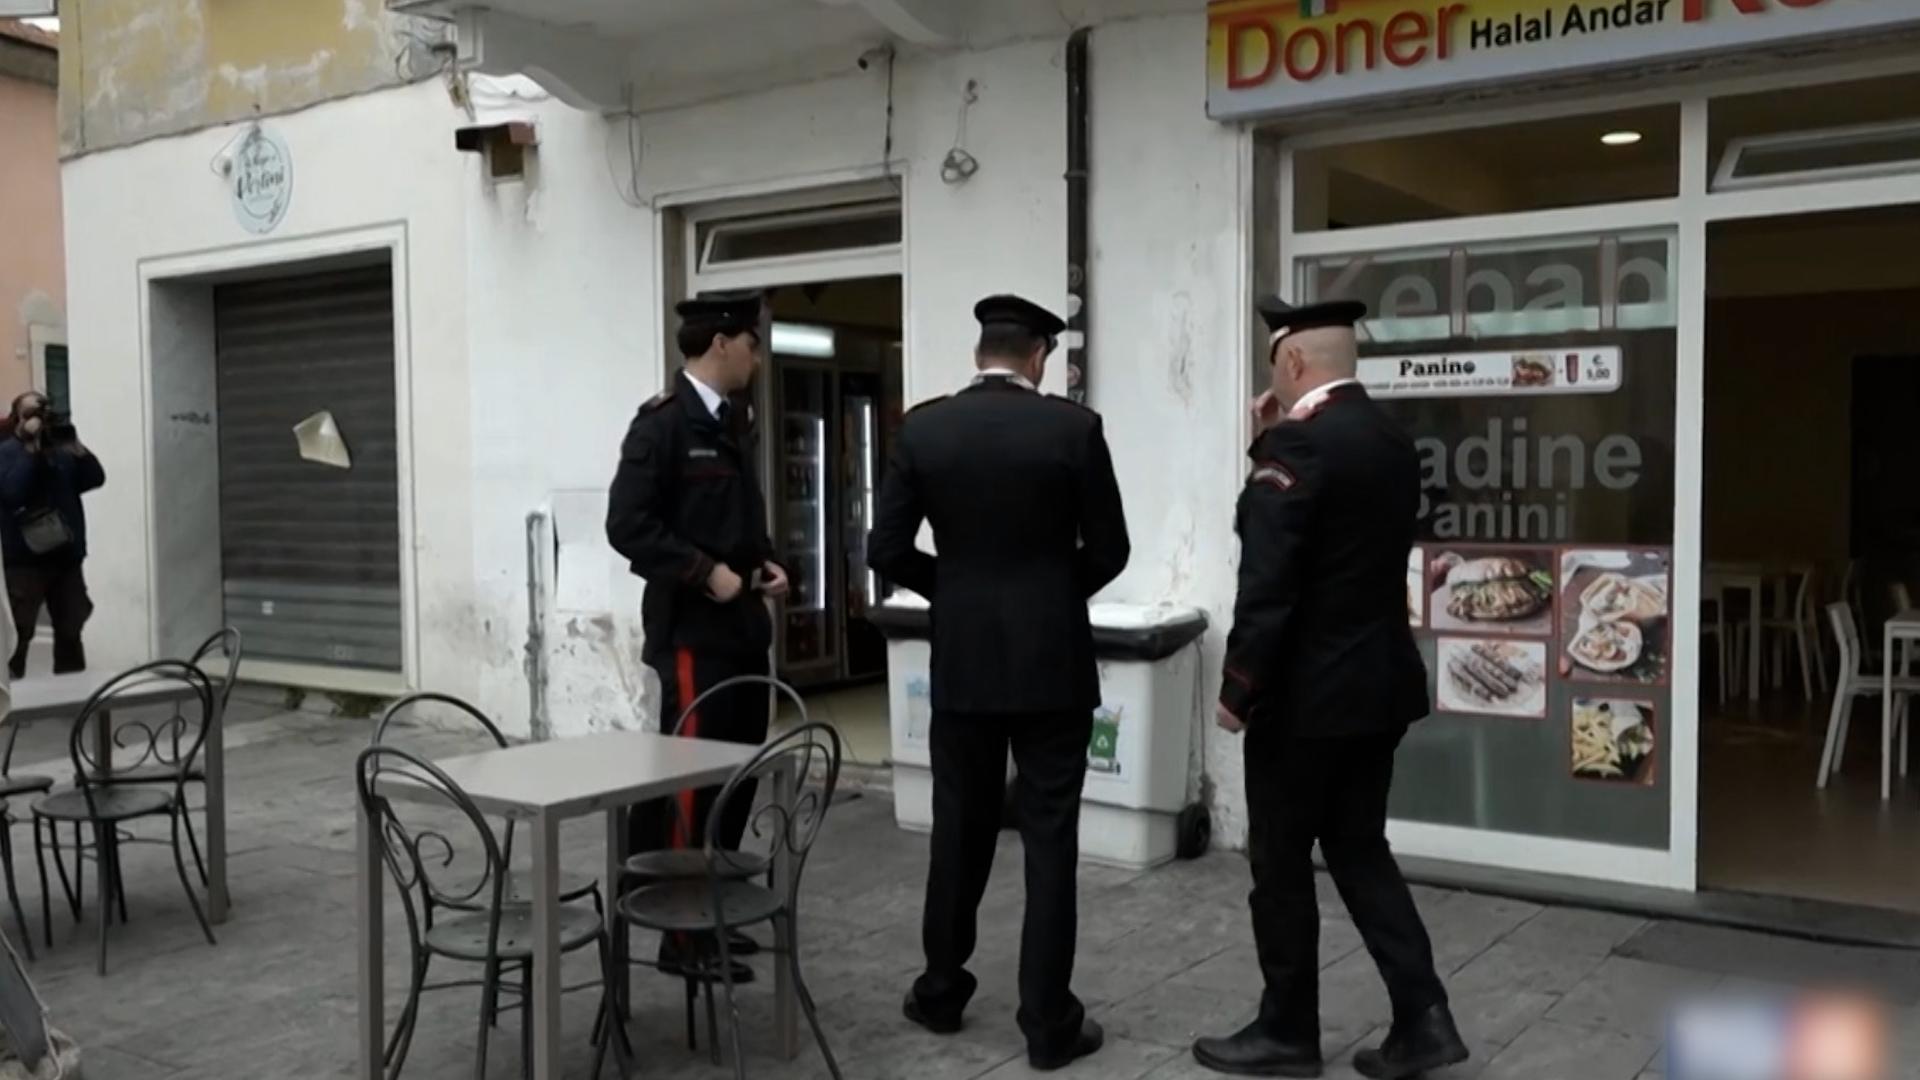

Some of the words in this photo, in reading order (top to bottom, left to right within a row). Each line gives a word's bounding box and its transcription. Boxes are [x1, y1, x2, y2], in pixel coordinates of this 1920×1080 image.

[1227, 4, 1465, 90] Doner
[1470, 7, 1552, 50] Halal
[1561, 0, 1671, 37] Andar
[1400, 357, 1476, 378] Panino
